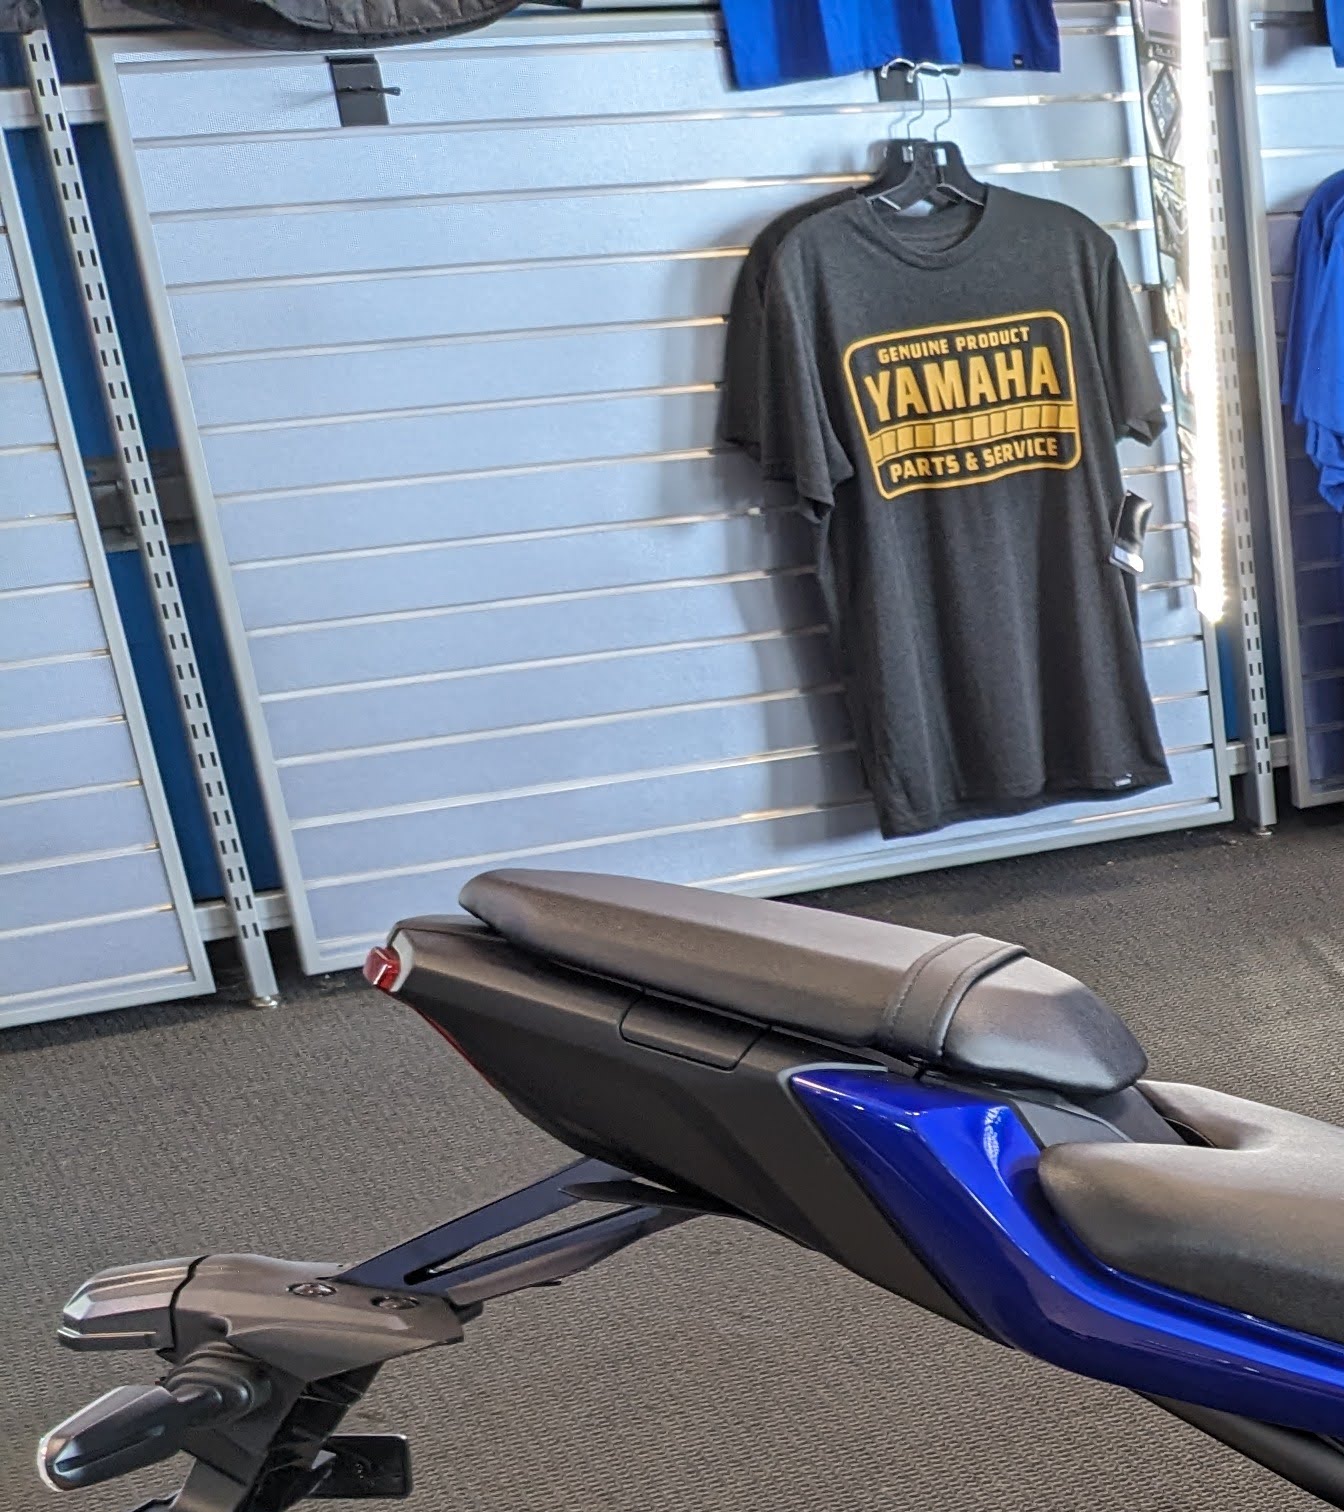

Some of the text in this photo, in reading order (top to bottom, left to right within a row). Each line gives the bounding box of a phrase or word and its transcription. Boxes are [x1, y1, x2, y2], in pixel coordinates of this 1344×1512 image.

[877, 326, 1030, 364] GENUINE PRODUCT
[863, 346, 1061, 423] YAMAHA
[889, 437, 1058, 484] PARTS & SERVICE
